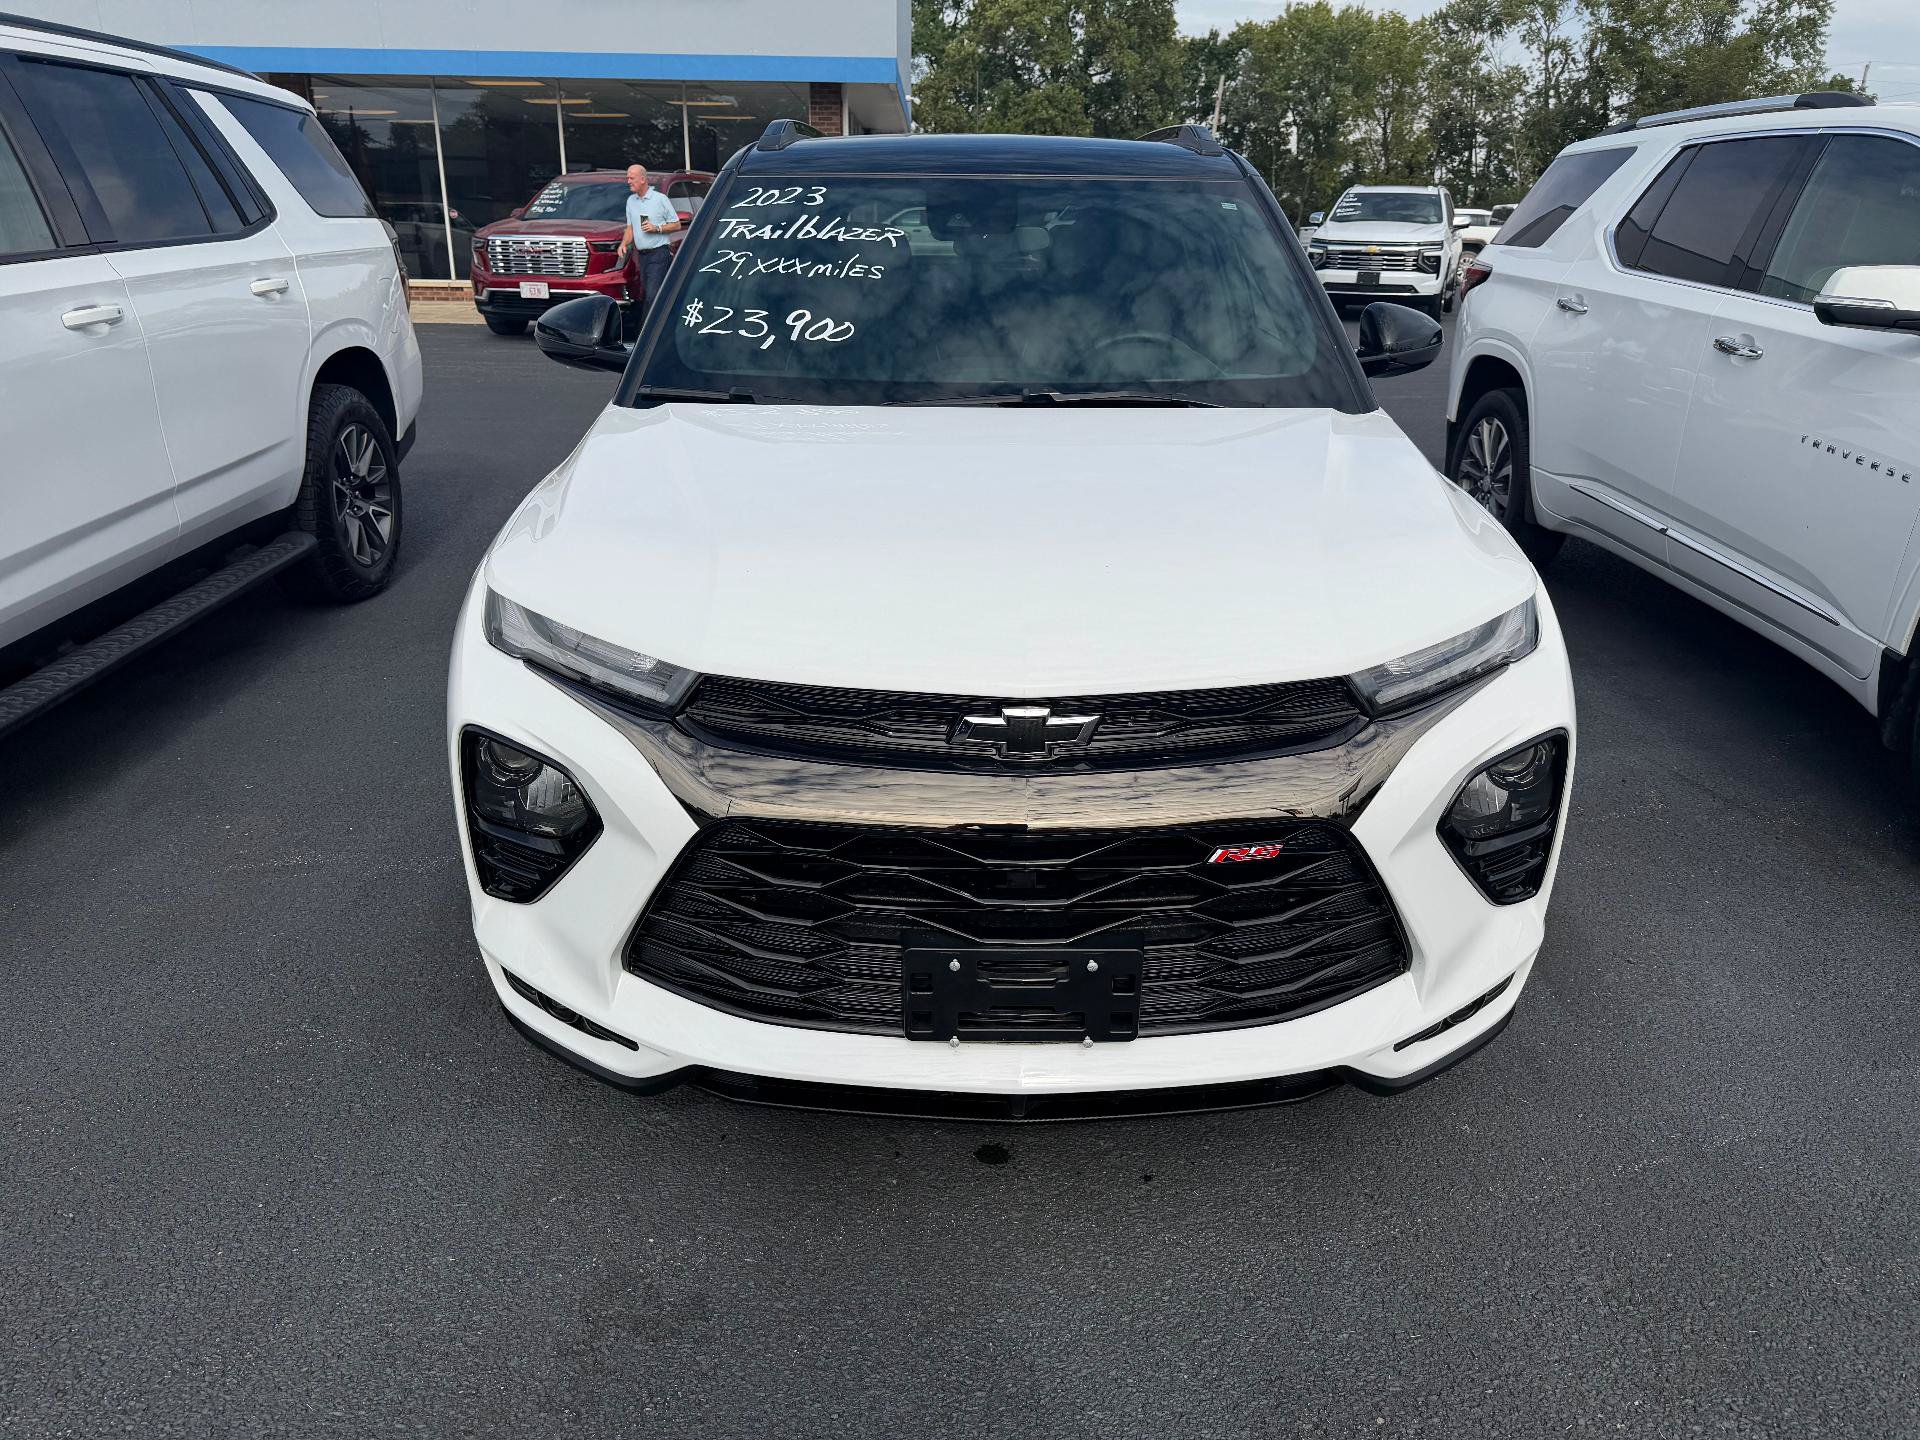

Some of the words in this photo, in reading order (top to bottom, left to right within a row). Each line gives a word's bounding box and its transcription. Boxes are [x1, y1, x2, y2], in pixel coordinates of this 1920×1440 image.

[731, 186, 829, 209] 2023
[682, 298, 855, 350] $23,900
[1800, 433, 1913, 484] TRAVERSE
[1207, 843, 1284, 865] RS
